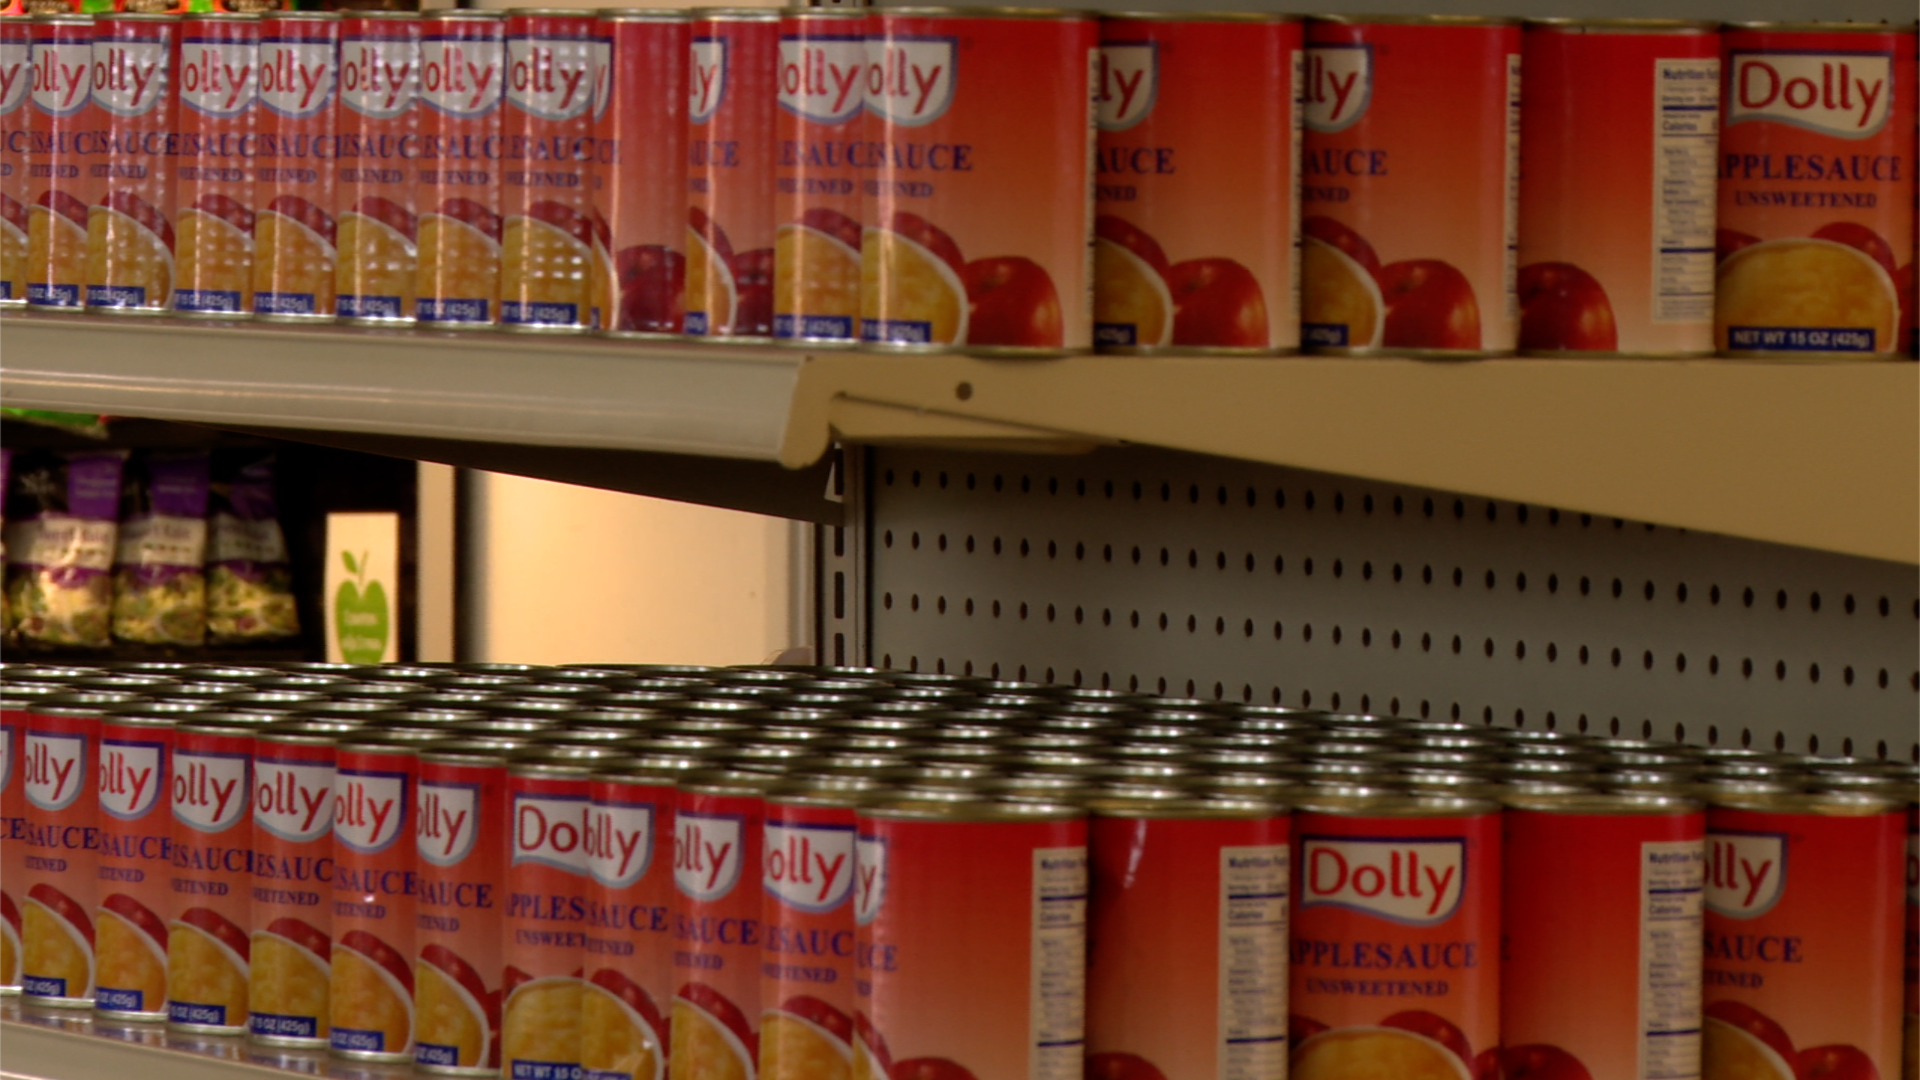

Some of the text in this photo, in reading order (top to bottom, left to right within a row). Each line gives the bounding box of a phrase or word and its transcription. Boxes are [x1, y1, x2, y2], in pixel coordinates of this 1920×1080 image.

[34, 50, 85, 107] olly
[94, 48, 156, 106] olly
[184, 49, 250, 109] olly
[262, 48, 325, 108] olly
[345, 47, 409, 108] olly
[428, 47, 493, 108] olly
[512, 46, 584, 109] olly
[784, 48, 861, 113] olly
[868, 48, 941, 115] olly
[1740, 61, 1884, 128] Dolly
[1717, 153, 1902, 181] PPLESAUCE
[1735, 191, 1877, 209] UNSWEETENED
[1734, 331, 1759, 343] NET
[1763, 331, 1785, 343] WT
[1809, 332, 1830, 345] OZ
[174, 763, 237, 822] olly
[257, 772, 329, 832] olly
[336, 783, 393, 844] olly
[519, 804, 588, 853] Dol
[768, 836, 846, 902] olly
[1309, 846, 1457, 916] Dolly
[1291, 941, 1478, 971] PPLESAUCE
[1305, 978, 1450, 998] UNSWEETENED
[569, 1067, 582, 1080] O
